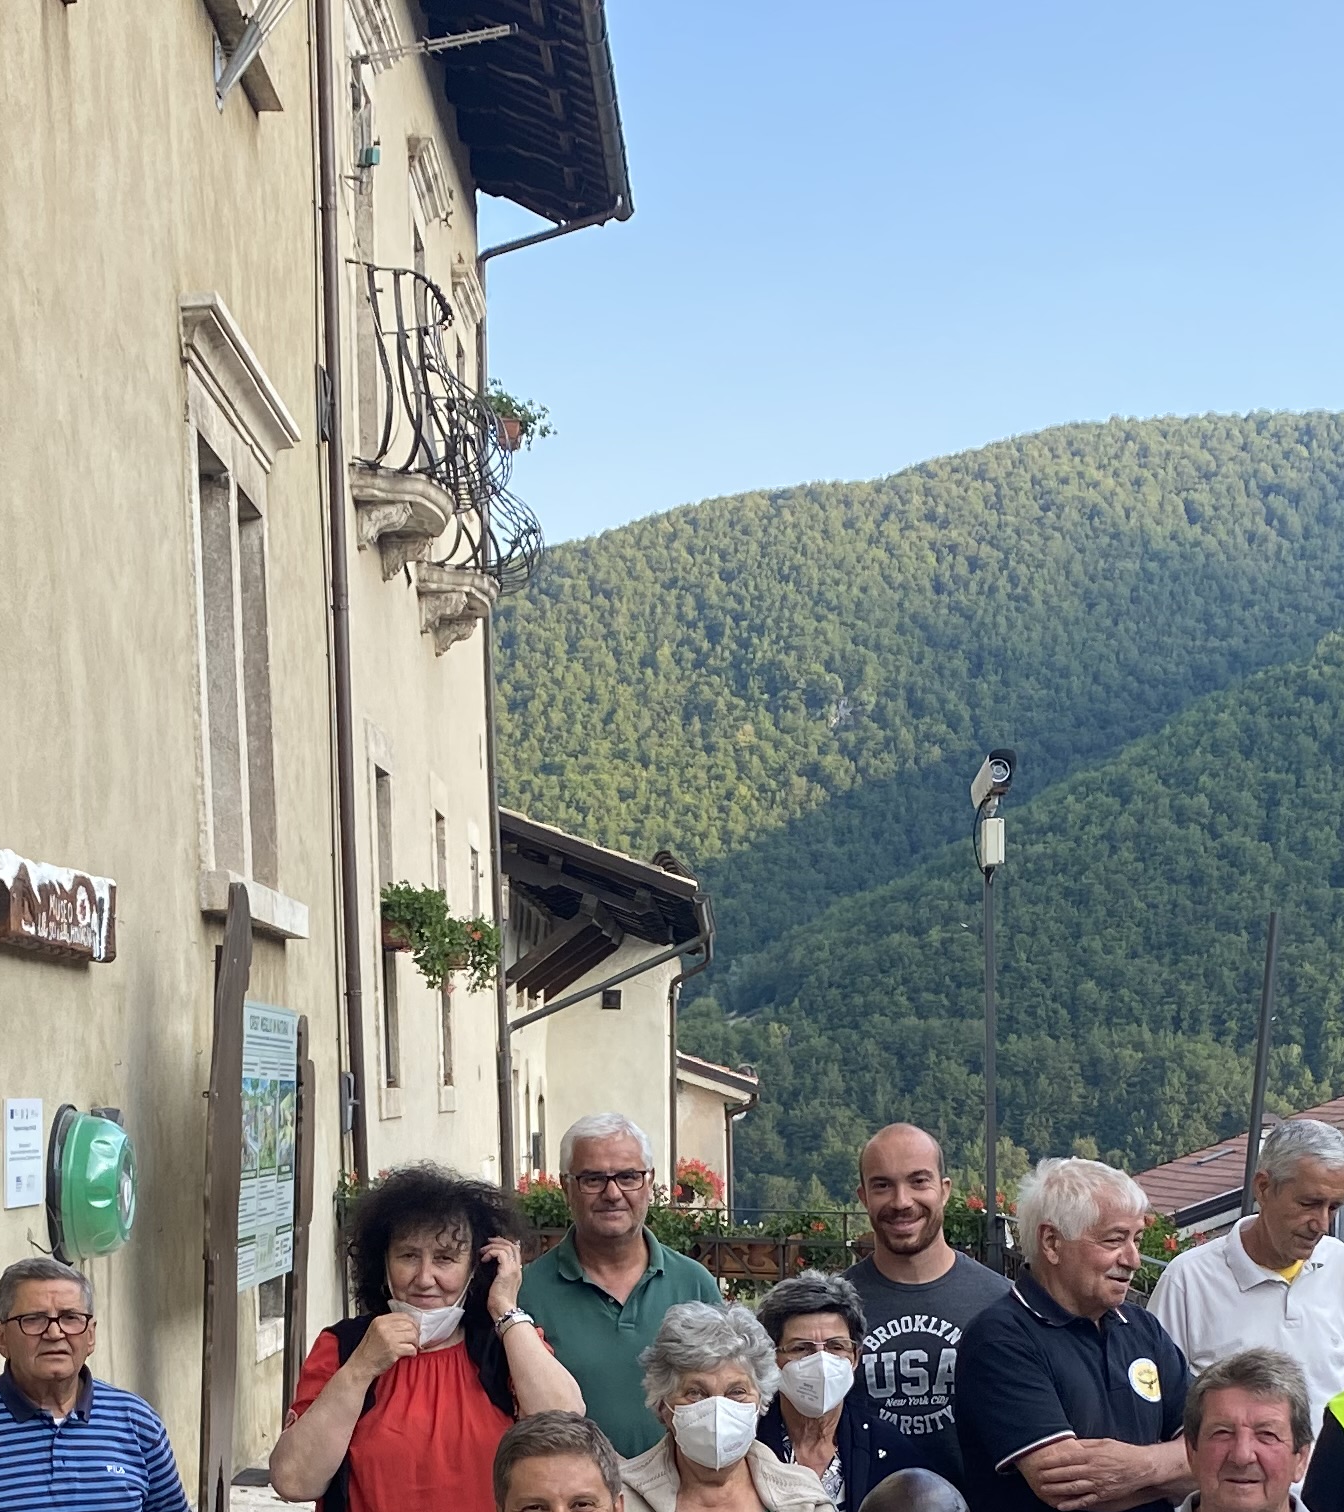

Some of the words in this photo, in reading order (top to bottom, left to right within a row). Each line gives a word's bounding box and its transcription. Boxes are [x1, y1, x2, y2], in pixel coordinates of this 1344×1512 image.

[863, 1314, 963, 1352] BROOKLYN
[862, 1348, 957, 1399] USA
[885, 1397, 907, 1407] New
[908, 1395, 929, 1406] York
[930, 1395, 950, 1407] City
[879, 1404, 956, 1435] VARSITY
[106, 1464, 126, 1475] FILA
